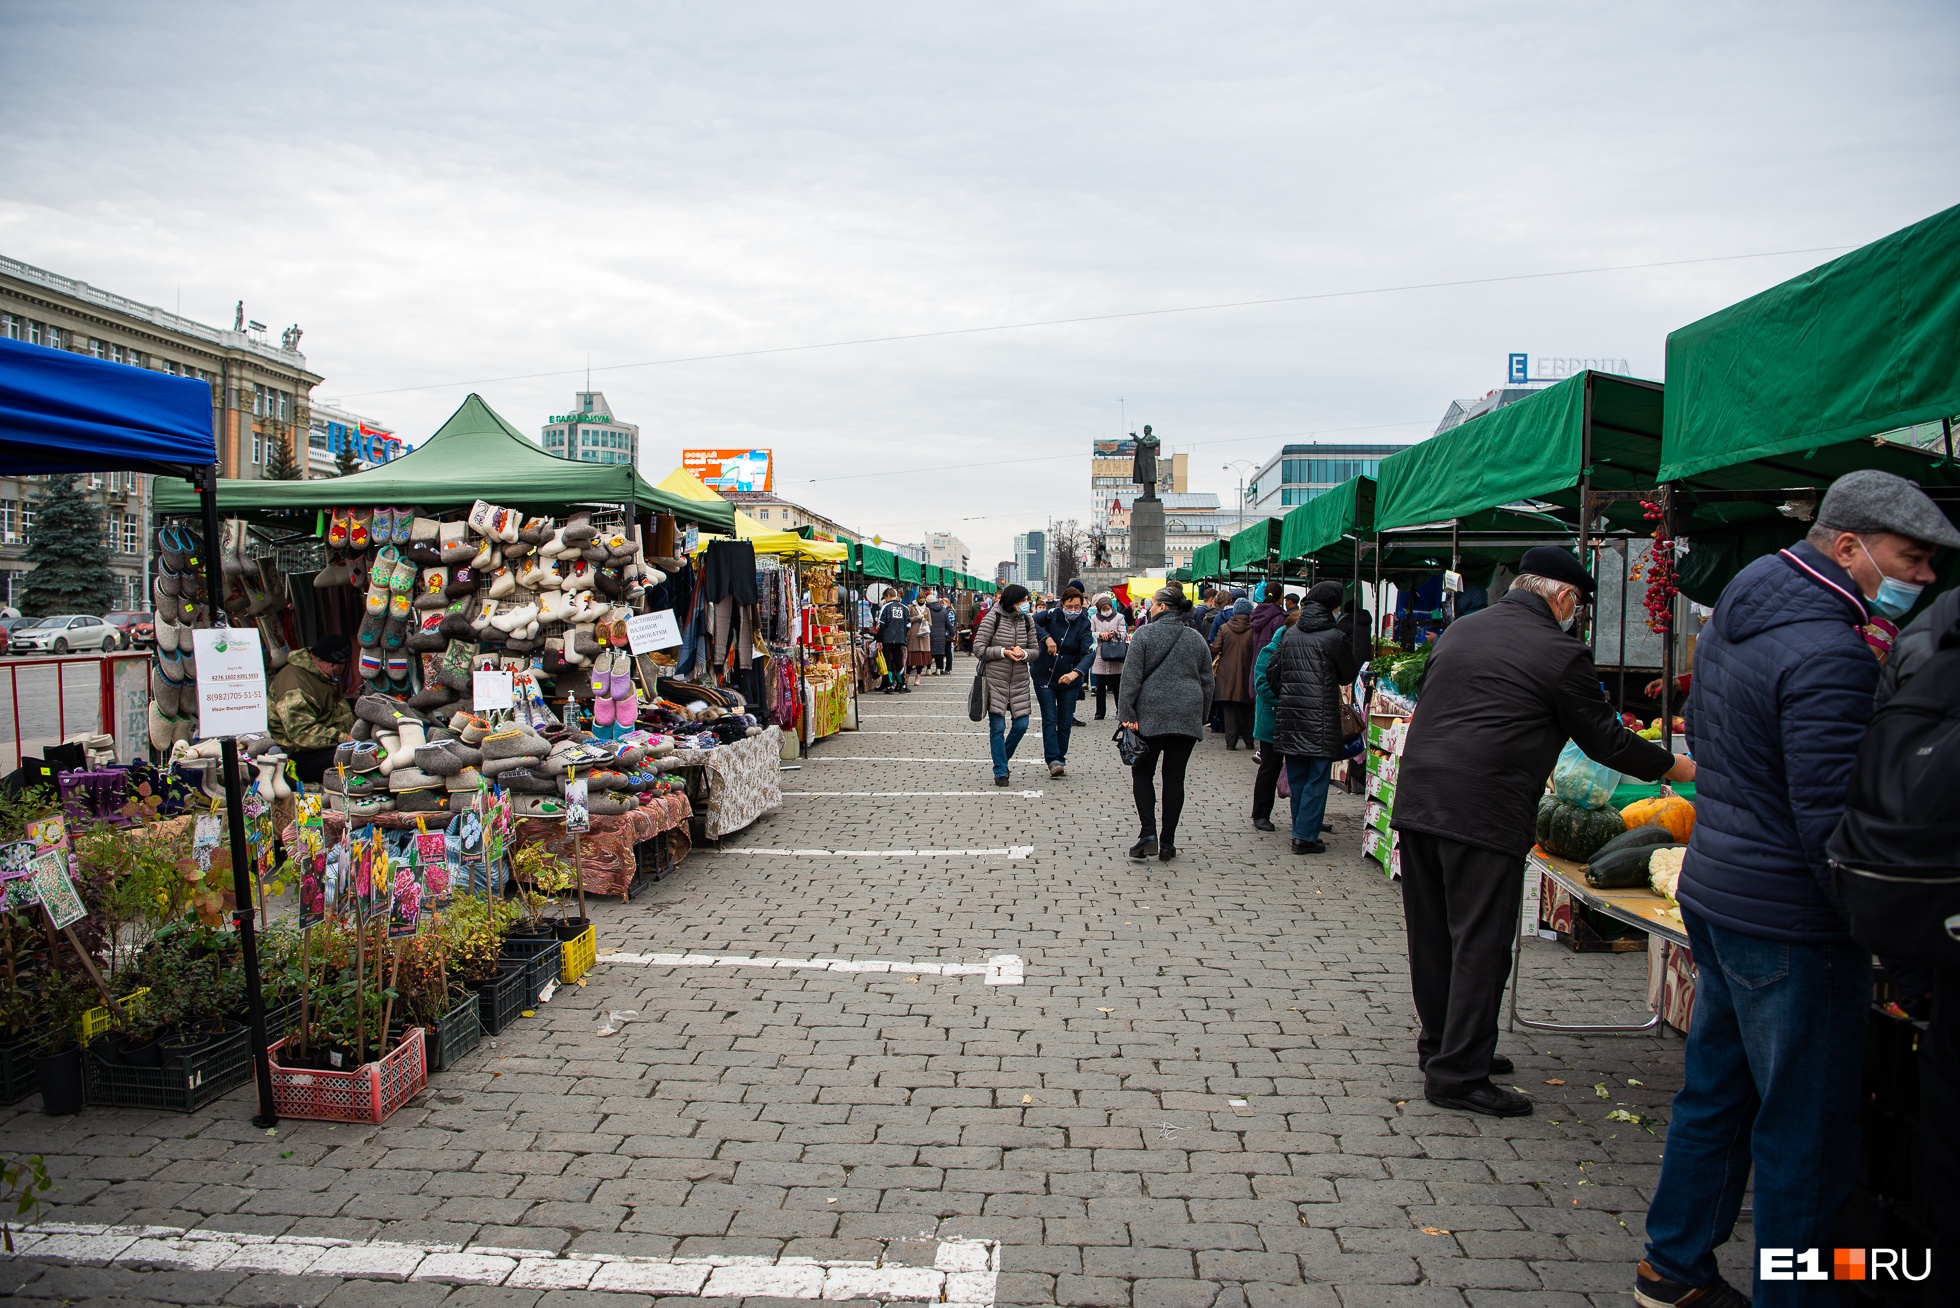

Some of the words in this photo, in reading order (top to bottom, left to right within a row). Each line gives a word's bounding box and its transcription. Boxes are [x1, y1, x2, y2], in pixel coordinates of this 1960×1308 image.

[1538, 357, 1630, 377] ЕВРОПА
[556, 415, 610, 423] ПАЛЛАДИУМ
[1097, 462, 1134, 473] SAMS
[627, 613, 664, 626] НАСТОЯЩИЕ
[630, 623, 658, 634] ВАЛЕНКИ
[632, 629, 668, 642] САМОКАТКИ
[206, 690, 262, 702] 8(982)705-51-51
[225, 704, 257, 712] Филаретович
